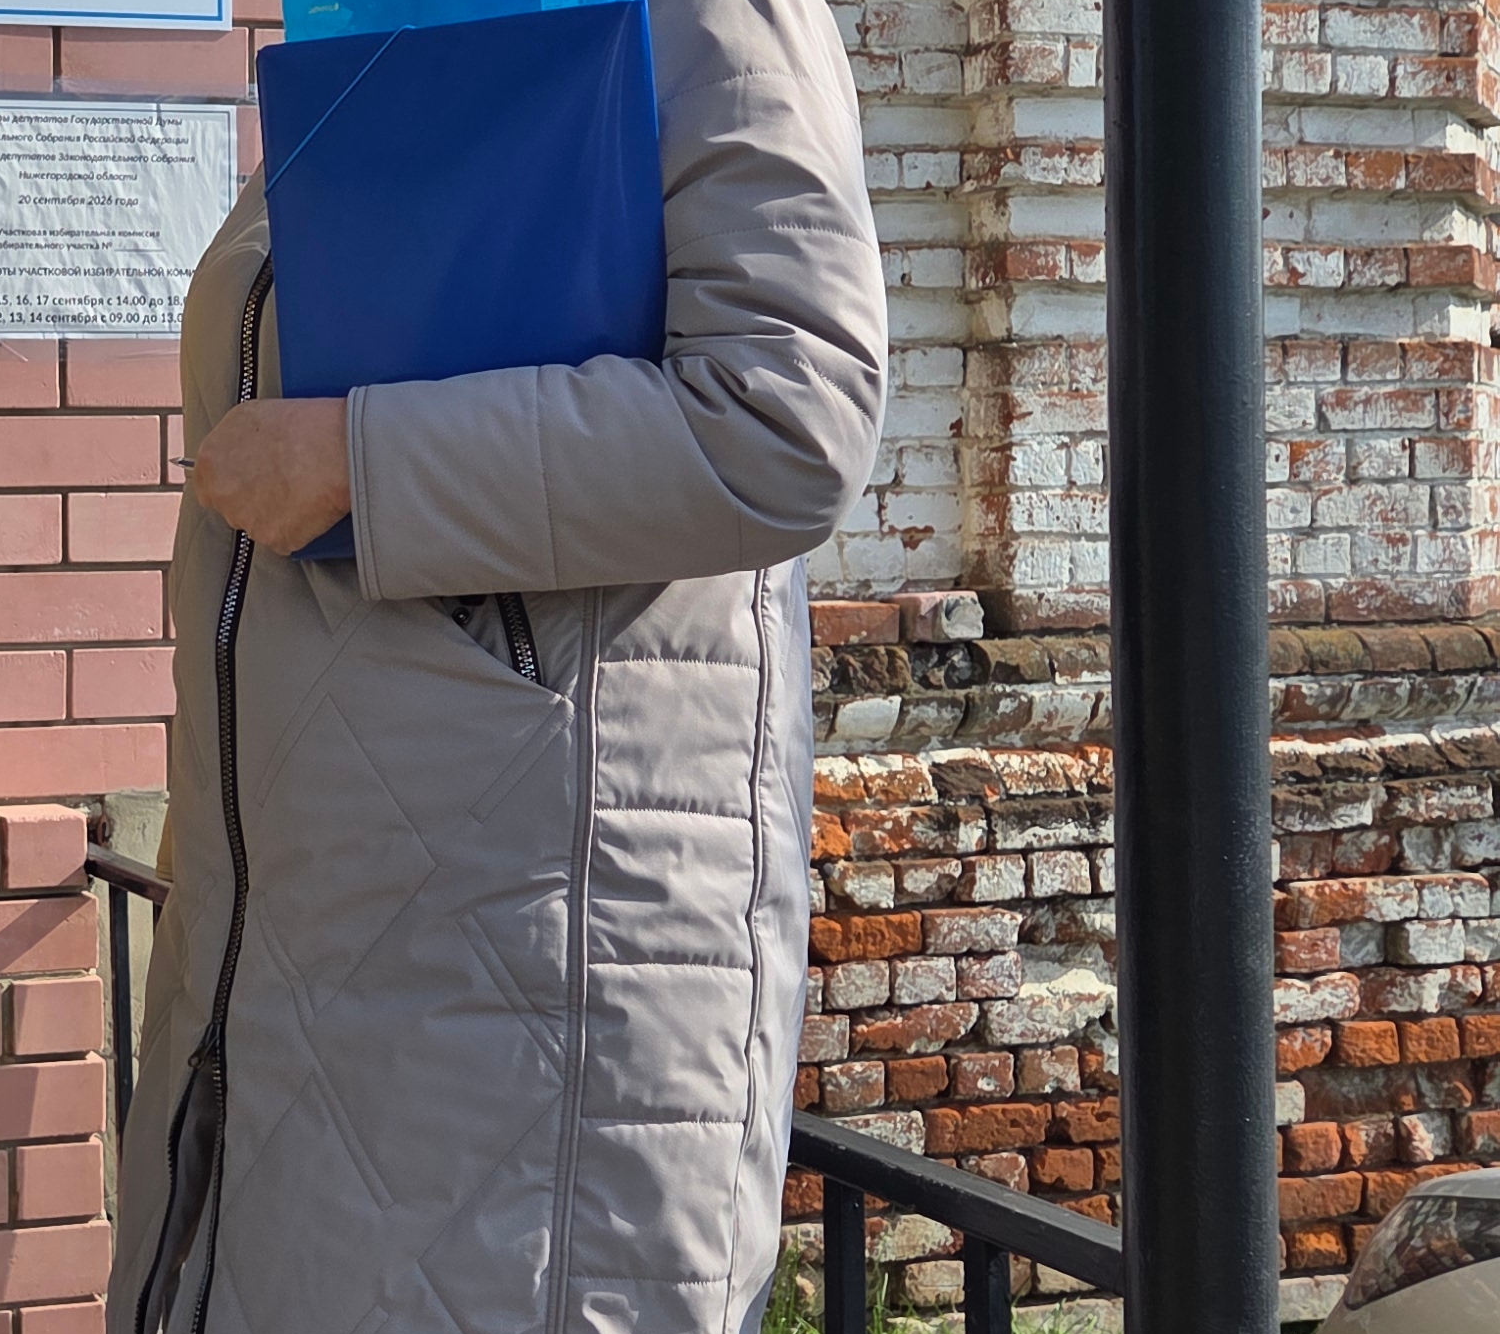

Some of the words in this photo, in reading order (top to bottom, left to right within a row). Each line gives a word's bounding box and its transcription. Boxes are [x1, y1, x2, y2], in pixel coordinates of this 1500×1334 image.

[11, 114, 69, 125] депутатов
[70, 114, 154, 126] Государственной
[155, 117, 183, 128] Думы
[35, 132, 81, 144] Собрания
[83, 133, 136, 144] Российской
[137, 135, 190, 147] Федерации
[0, 152, 57, 163] депутатов
[58, 152, 149, 164] Законодательного
[150, 153, 196, 164] Собрания
[18, 170, 95, 182] Нижегородской
[96, 170, 138, 182] области
[18, 194, 32, 205] 20
[33, 195, 86, 207] сентября
[86, 195, 113, 206] 2026
[114, 197, 140, 208] года
[48, 227, 116, 239] избирательная
[117, 230, 161, 238] комиссия
[66, 242, 100, 252] участка
[18, 266, 81, 277] УЧАСТКОВОЙ
[83, 266, 165, 278] ИЗБИРАТЕЛЬНОЙ
[16, 294, 33, 307] 16,
[36, 294, 50, 306] 17
[52, 295, 104, 308] сентября
[116, 295, 147, 306] 14.00
[148, 297, 164, 308] до
[9, 312, 26, 324] 13,
[30, 312, 43, 323] 14
[45, 312, 98, 325] сентября
[109, 312, 140, 324] 09.00
[142, 314, 158, 325] до
